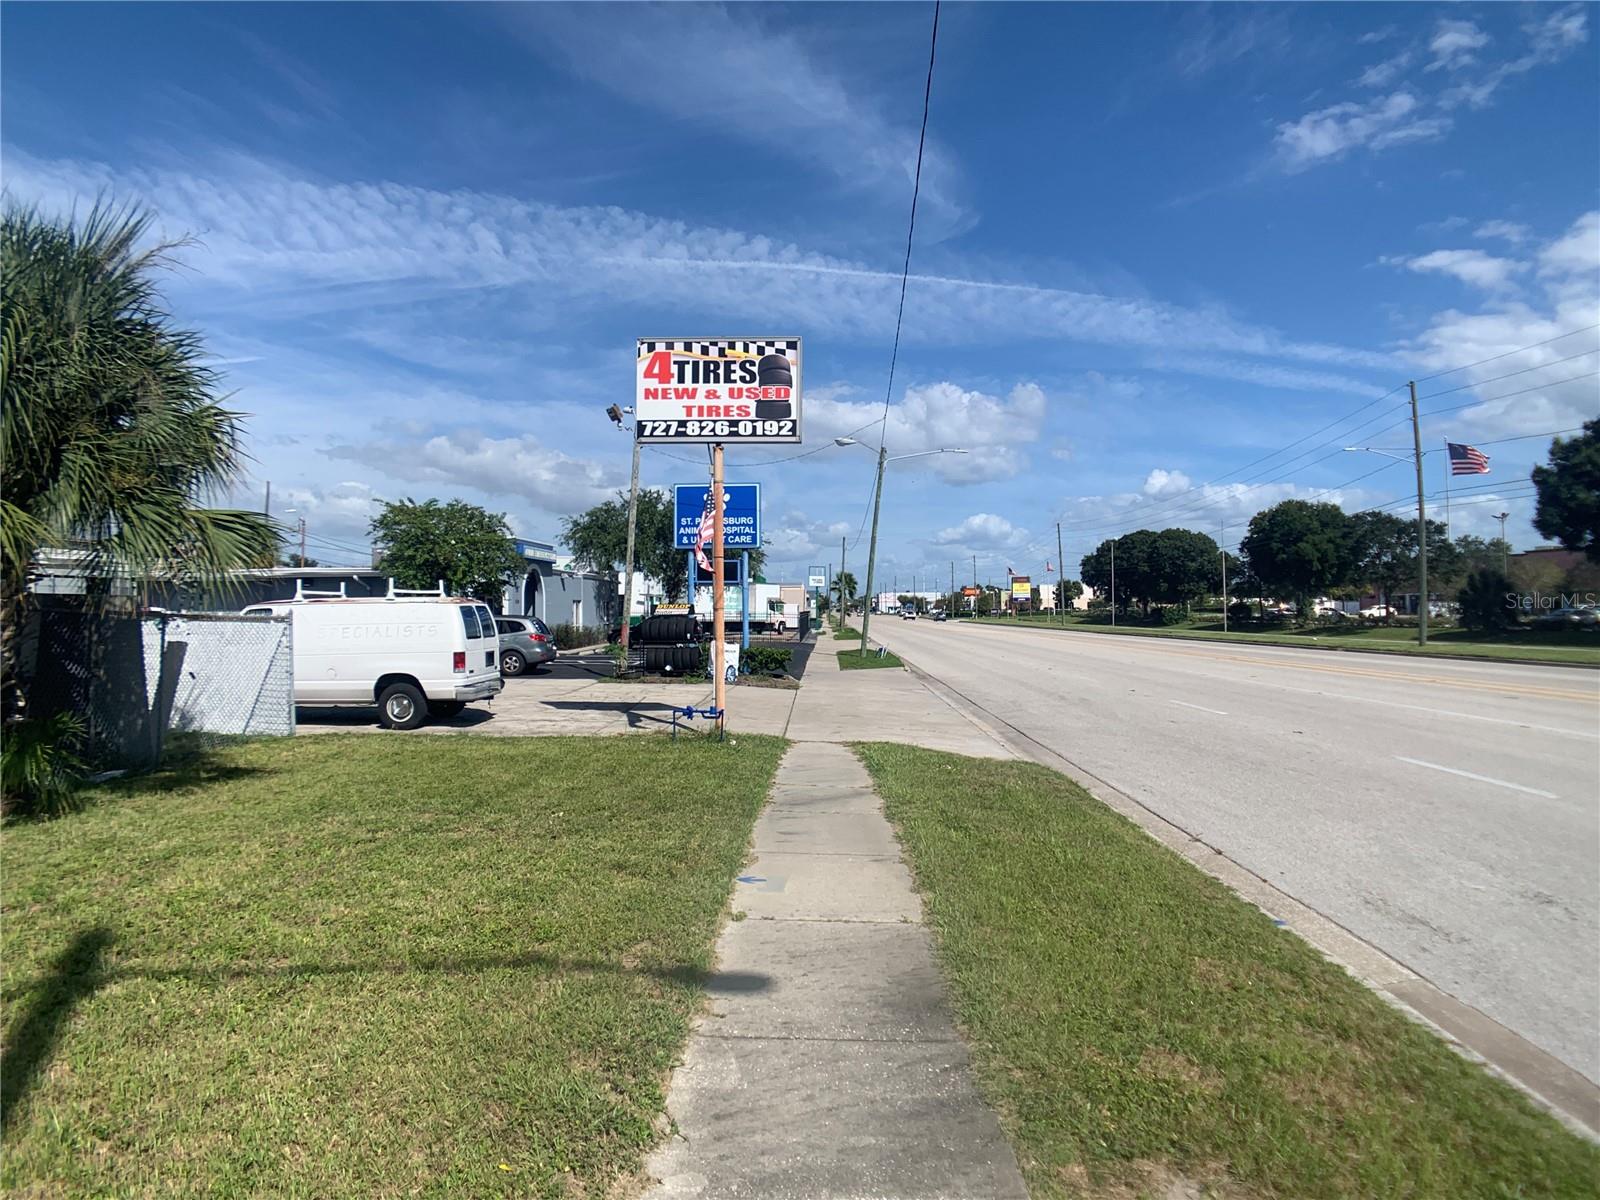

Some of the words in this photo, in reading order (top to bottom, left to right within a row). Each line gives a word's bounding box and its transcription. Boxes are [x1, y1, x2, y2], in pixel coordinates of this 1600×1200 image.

[644, 388, 698, 400] NEW
[704, 388, 721, 400] &
[728, 387, 791, 400] USED
[682, 405, 752, 418] TIRES
[641, 420, 793, 436] 727-826-0192
[680, 517, 693, 526] ST.
[728, 535, 753, 544] CARE
[317, 624, 440, 640] SPECIALISTS
